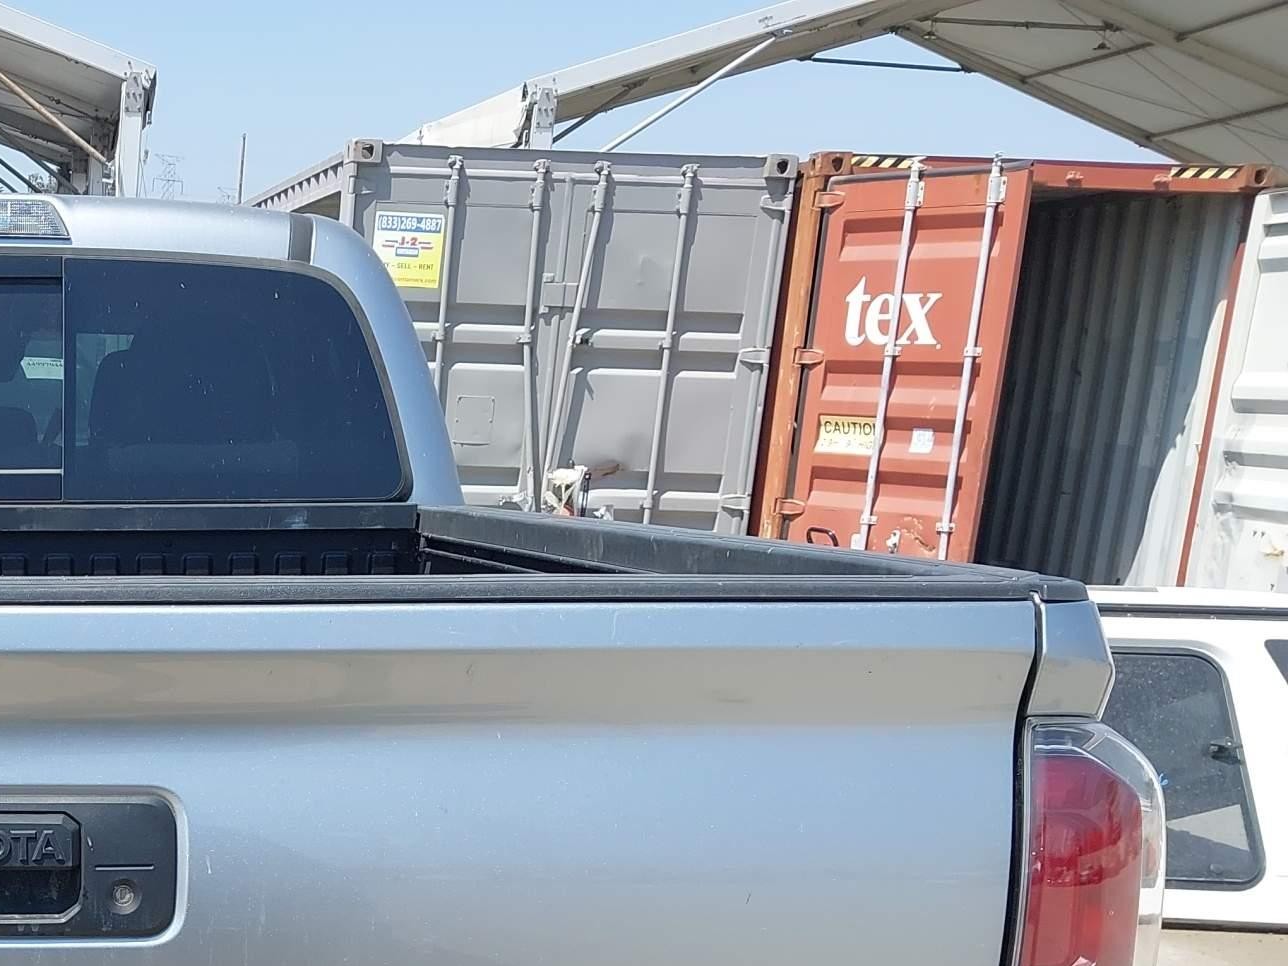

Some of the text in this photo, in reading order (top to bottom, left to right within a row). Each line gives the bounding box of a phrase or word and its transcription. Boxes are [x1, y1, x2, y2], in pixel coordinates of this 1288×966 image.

[378, 215, 442, 231] (833)269-4887
[396, 262, 411, 270] SELL
[418, 263, 434, 271] RENT
[823, 420, 876, 436] CAUTIO
